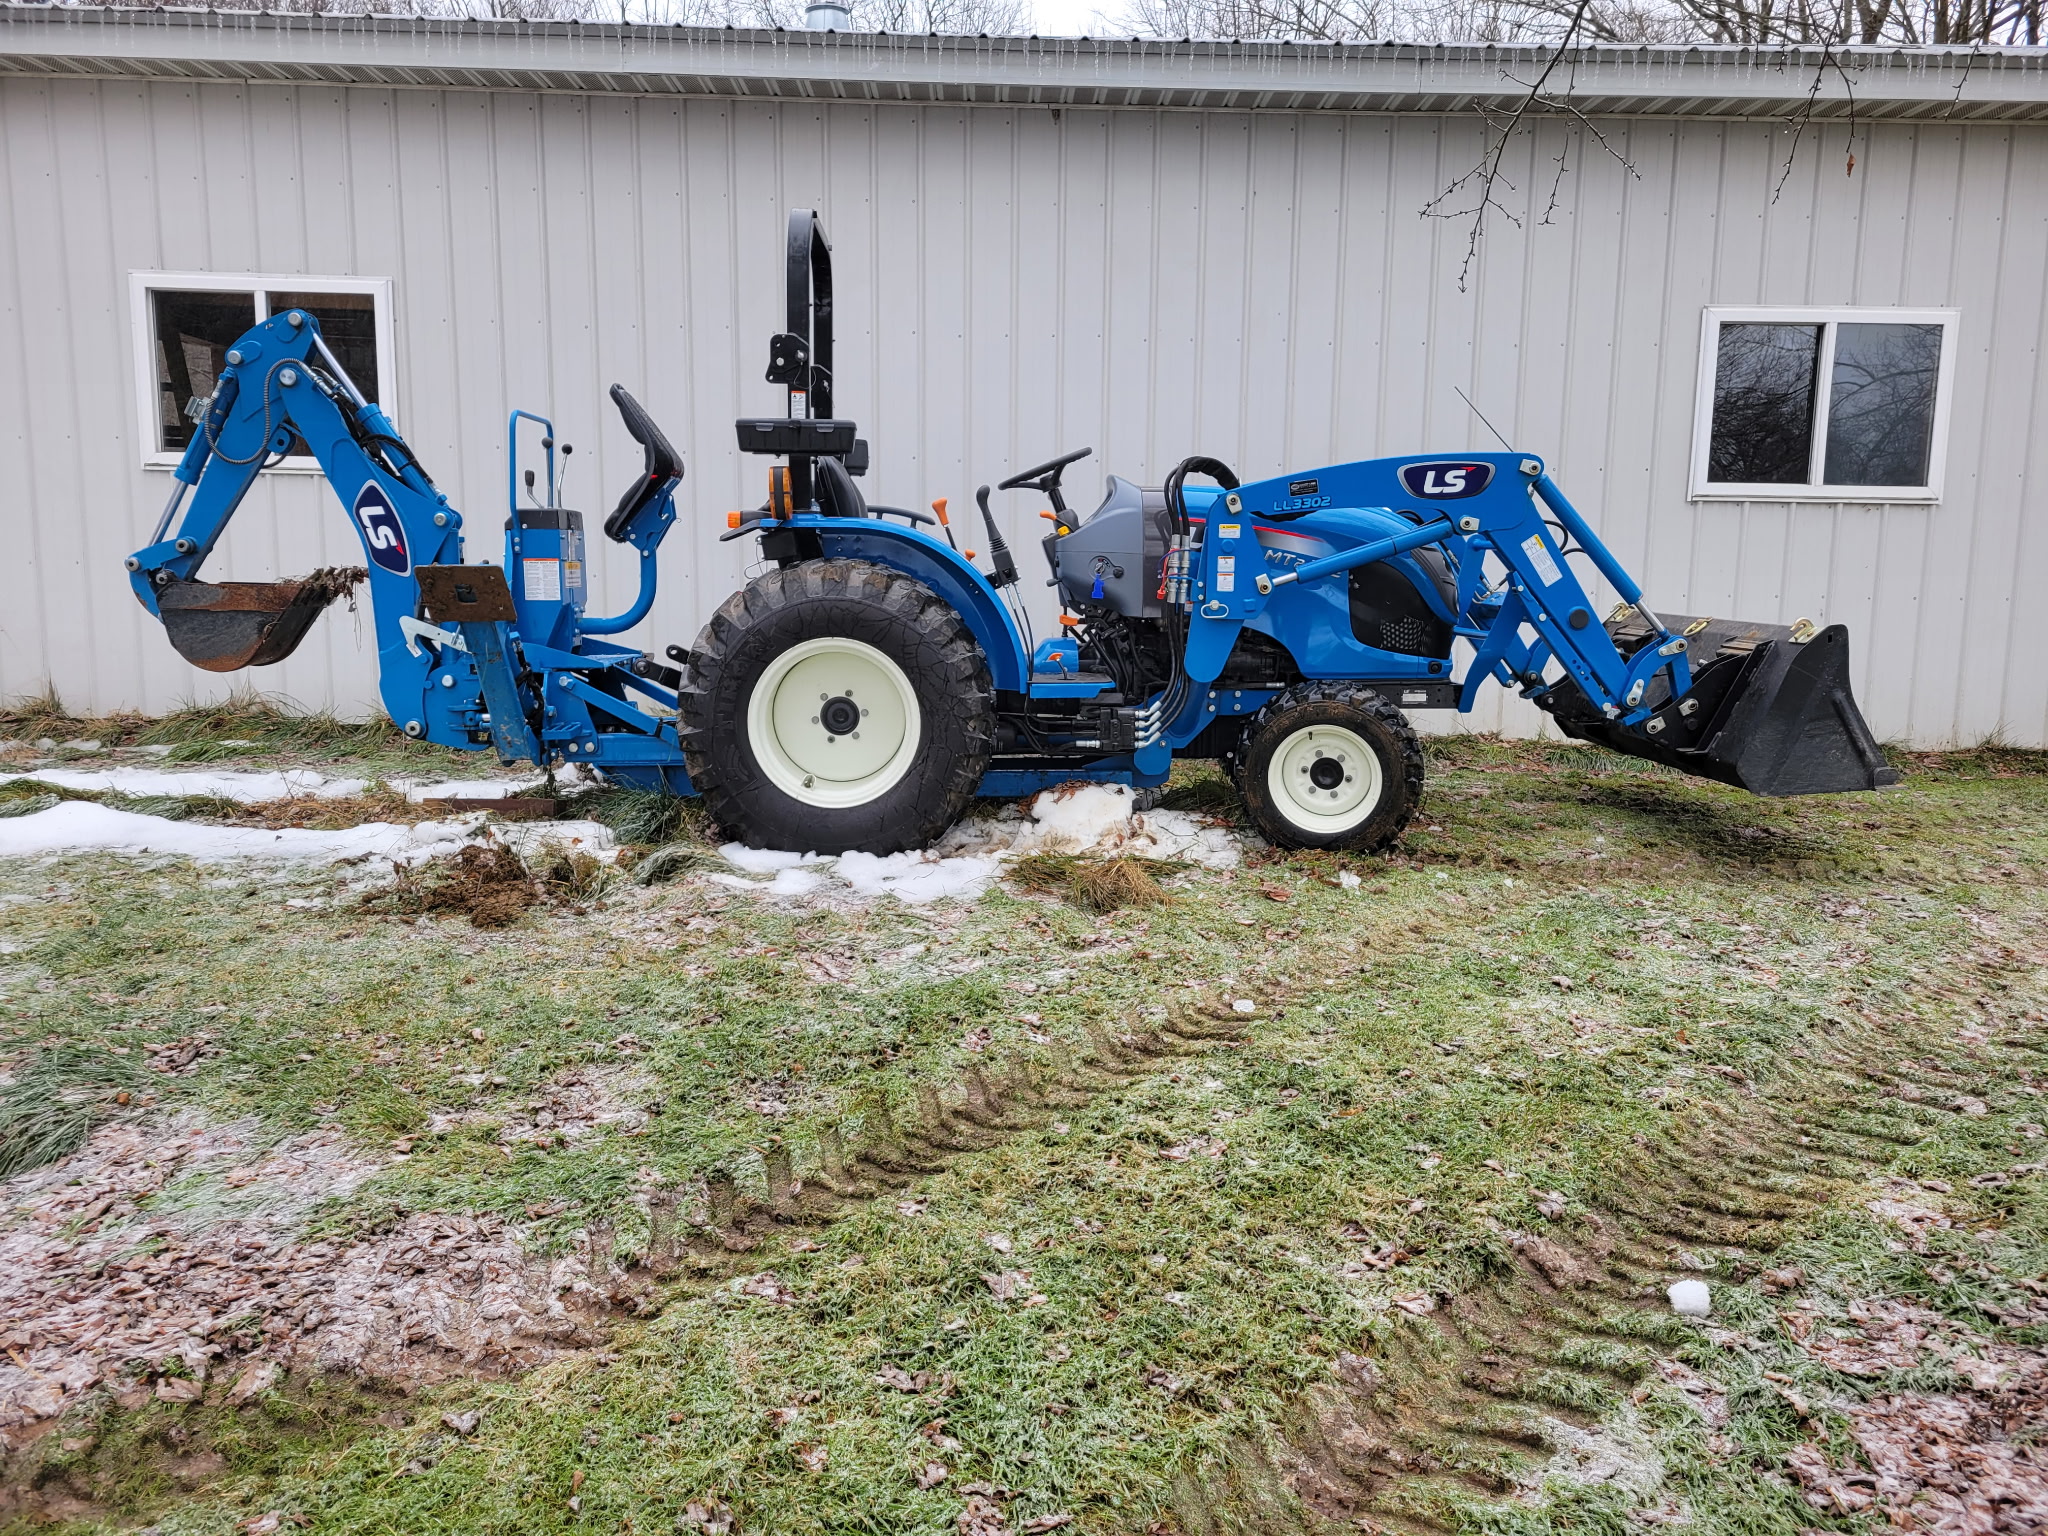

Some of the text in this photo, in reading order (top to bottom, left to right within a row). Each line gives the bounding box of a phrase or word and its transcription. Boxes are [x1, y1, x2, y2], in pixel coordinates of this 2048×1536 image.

[1423, 469, 1467, 494] LS
[1273, 496, 1331, 511] LL3302
[359, 505, 398, 550] LS
